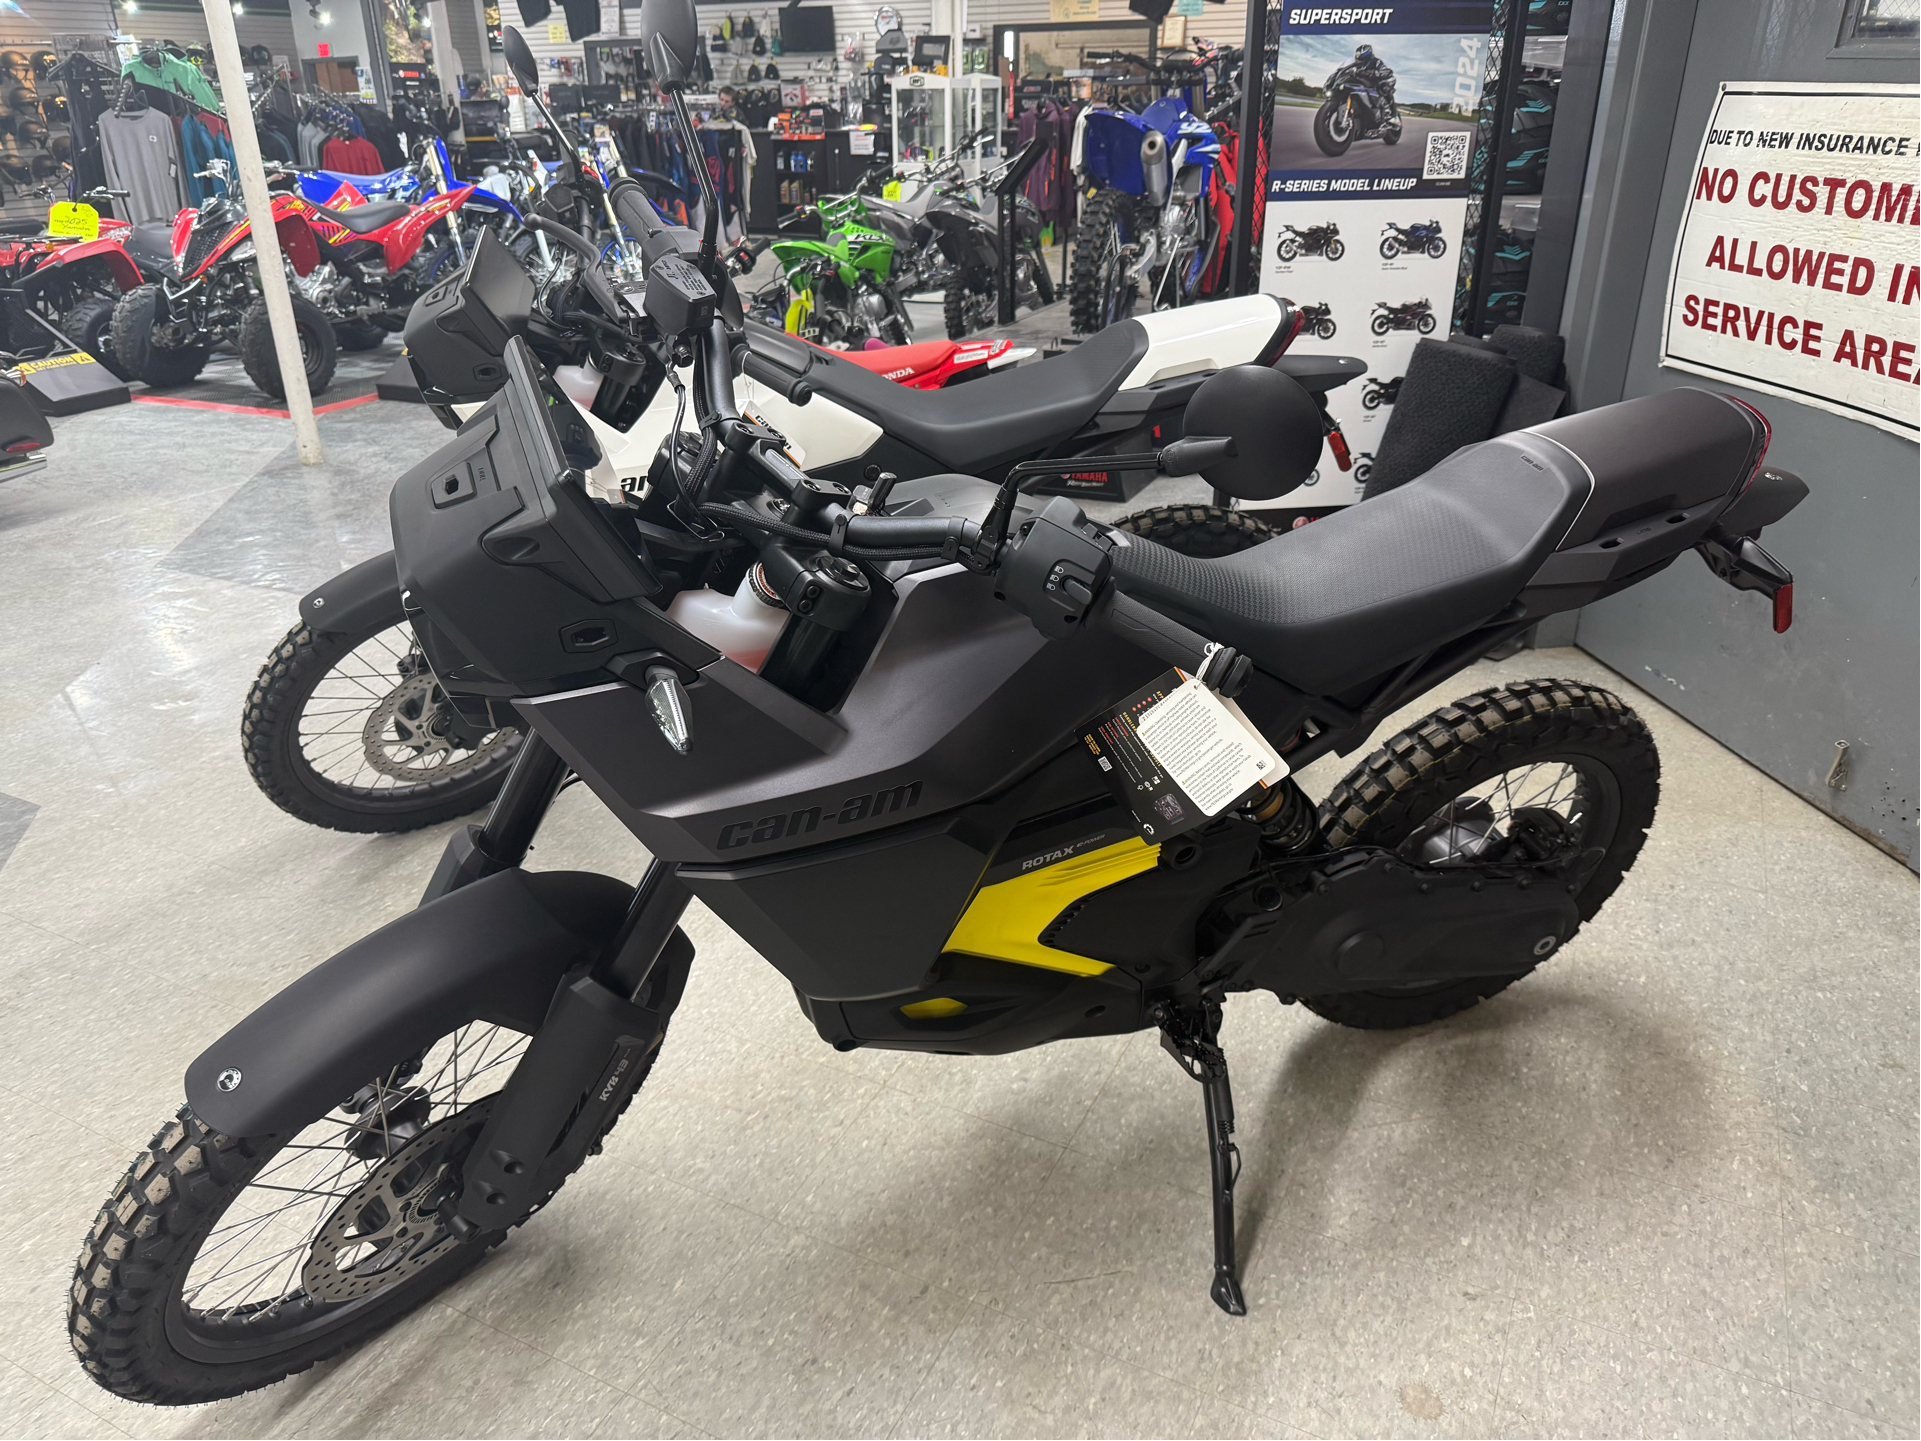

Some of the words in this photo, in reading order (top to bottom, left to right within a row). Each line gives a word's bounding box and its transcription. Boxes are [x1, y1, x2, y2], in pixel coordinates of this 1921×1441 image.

[1289, 8, 1394, 25] SUPERSPORT
[1451, 37, 1482, 117] 2024
[1709, 129, 1733, 146] DUE
[1737, 130, 1753, 147] TO
[1757, 131, 1794, 149] NEW
[1796, 132, 1911, 157] INSURANCE
[1271, 180, 1329, 193] R-SERIES
[1329, 179, 1371, 192] MODEL
[1372, 178, 1417, 190] LINEUP
[1695, 166, 1738, 204] NO
[1705, 235, 1876, 297] ALLOWED
[1682, 294, 1823, 359] SERVICE
[1833, 328, 1921, 385] ARE
[716, 779, 924, 850] can-am
[1022, 845, 1075, 871] ROTAX
[599, 1075, 619, 1102] KYB
